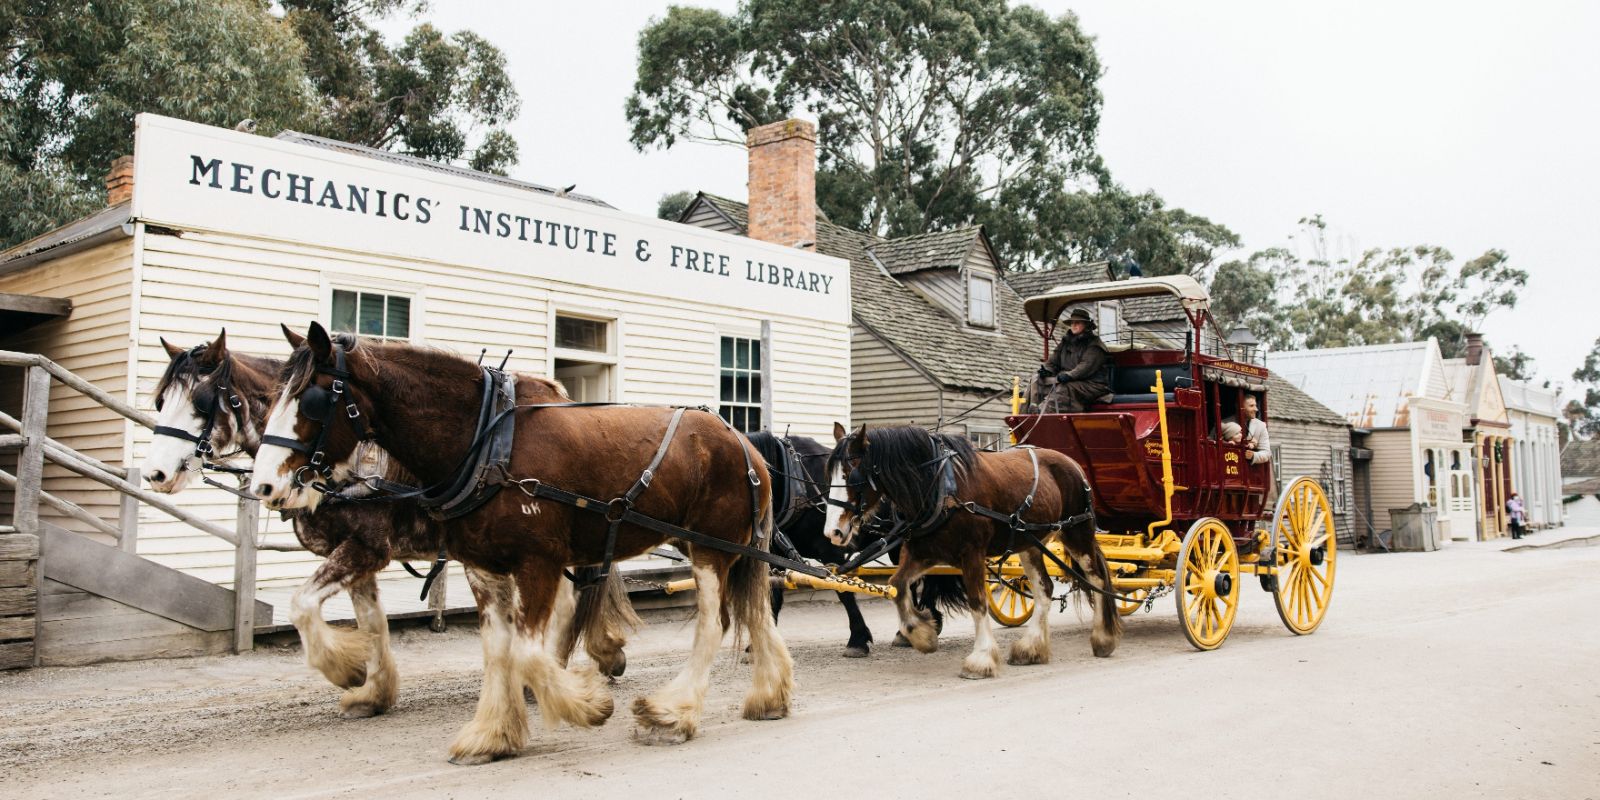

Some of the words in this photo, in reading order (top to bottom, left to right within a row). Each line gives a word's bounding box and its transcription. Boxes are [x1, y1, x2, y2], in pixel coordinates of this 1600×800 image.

[459, 205, 618, 258] INSTITUTE
[635, 239, 652, 262] &
[670, 245, 731, 278] FREE
[746, 260, 834, 296] LIBRARY
[1224, 451, 1239, 463] COBB
